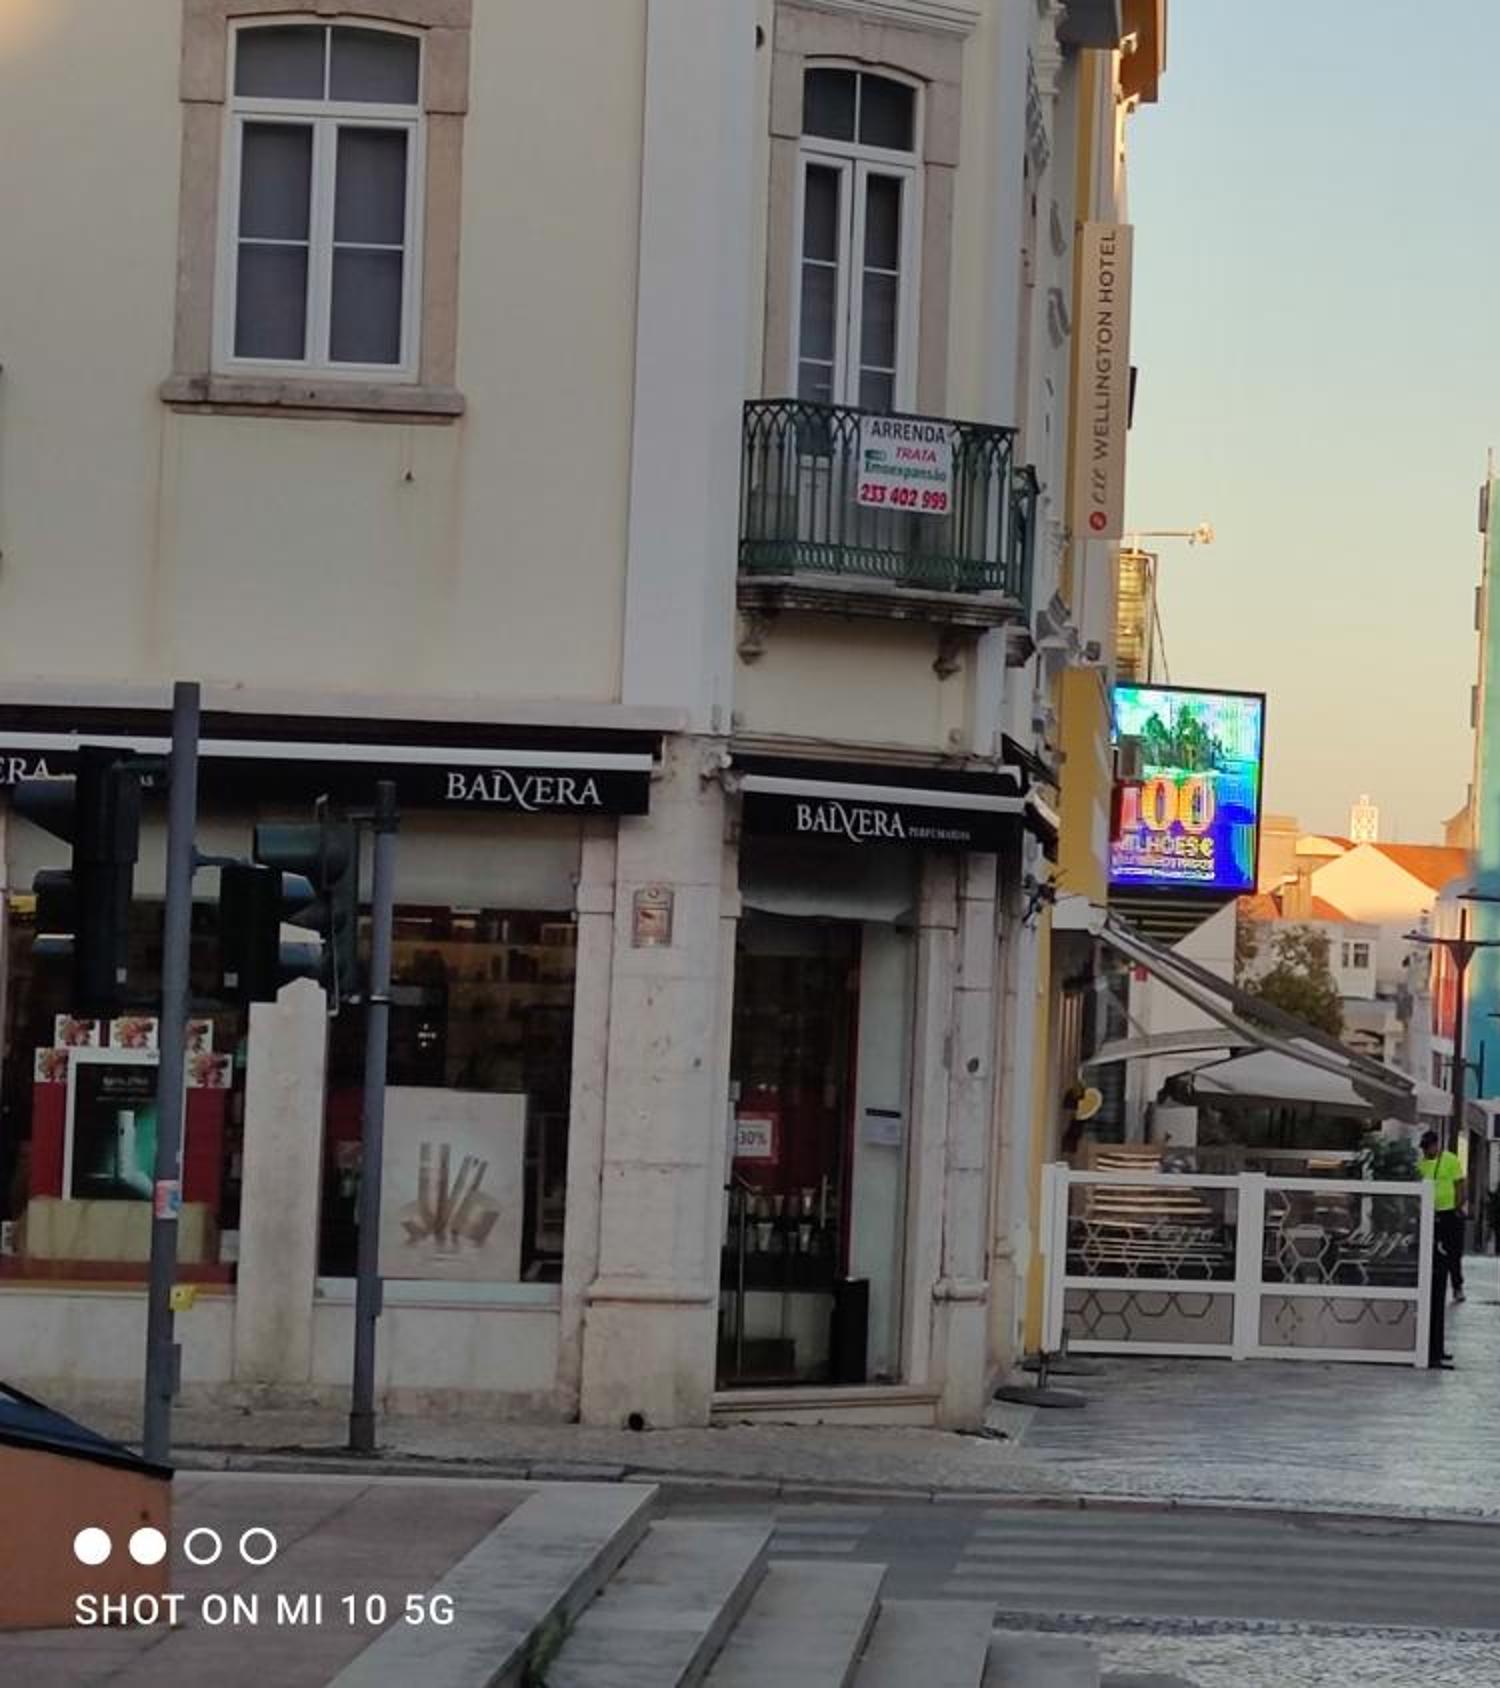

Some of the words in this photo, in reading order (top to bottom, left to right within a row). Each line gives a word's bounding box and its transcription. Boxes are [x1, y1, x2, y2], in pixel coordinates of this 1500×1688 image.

[1098, 229, 1117, 304] HOTEL
[1093, 311, 1113, 461] WELLINGTON
[871, 421, 945, 444] ARRENDA
[896, 447, 937, 463] TRATA
[861, 484, 887, 503] 233
[890, 488, 918, 507] 402
[446, 769, 603, 811] BALVERA
[797, 801, 905, 842] BALVERA
